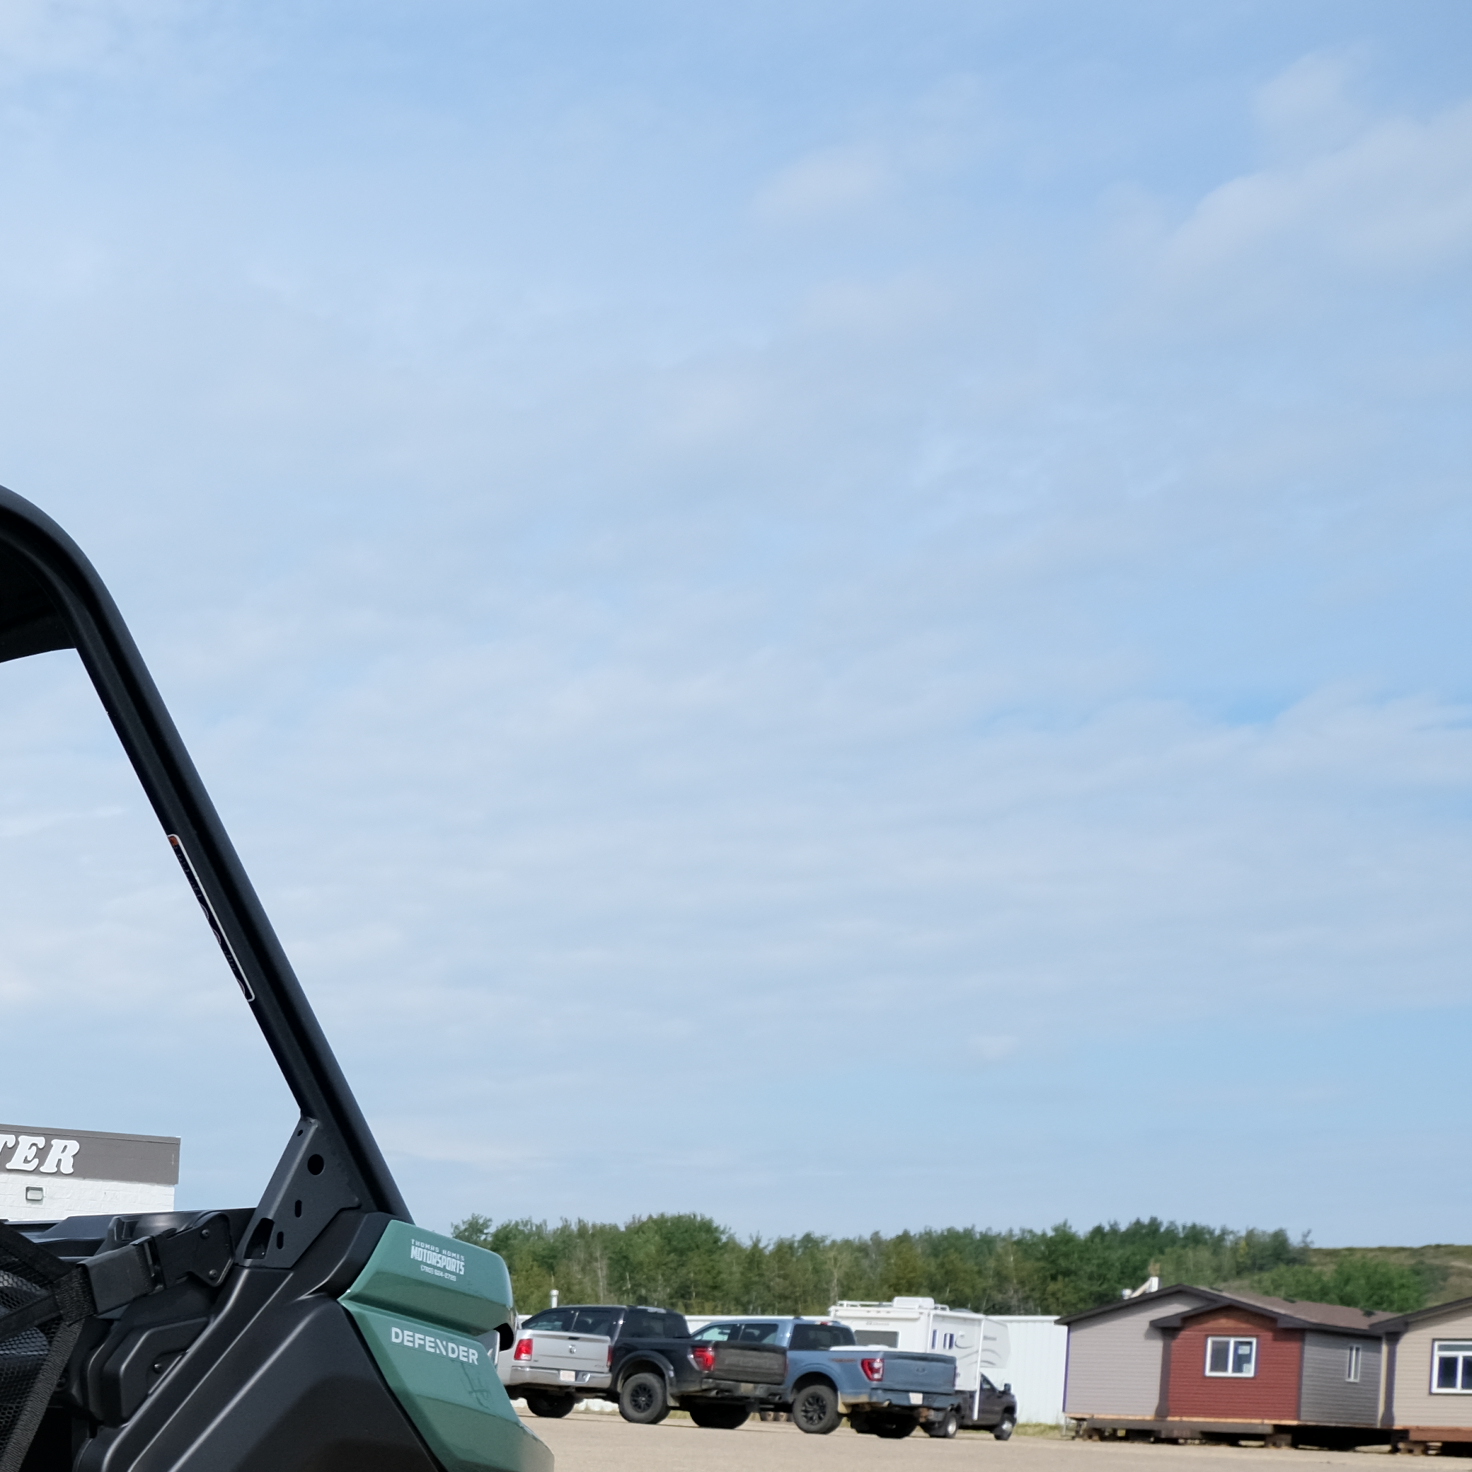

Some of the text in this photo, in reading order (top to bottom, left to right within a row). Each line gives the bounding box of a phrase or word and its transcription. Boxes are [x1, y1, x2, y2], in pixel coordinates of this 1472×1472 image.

[411, 1239, 465, 1261] THOMAS HOMES
[411, 1245, 465, 1275] MOTORSPORTS
[391, 1326, 479, 1365] DEFENDER
